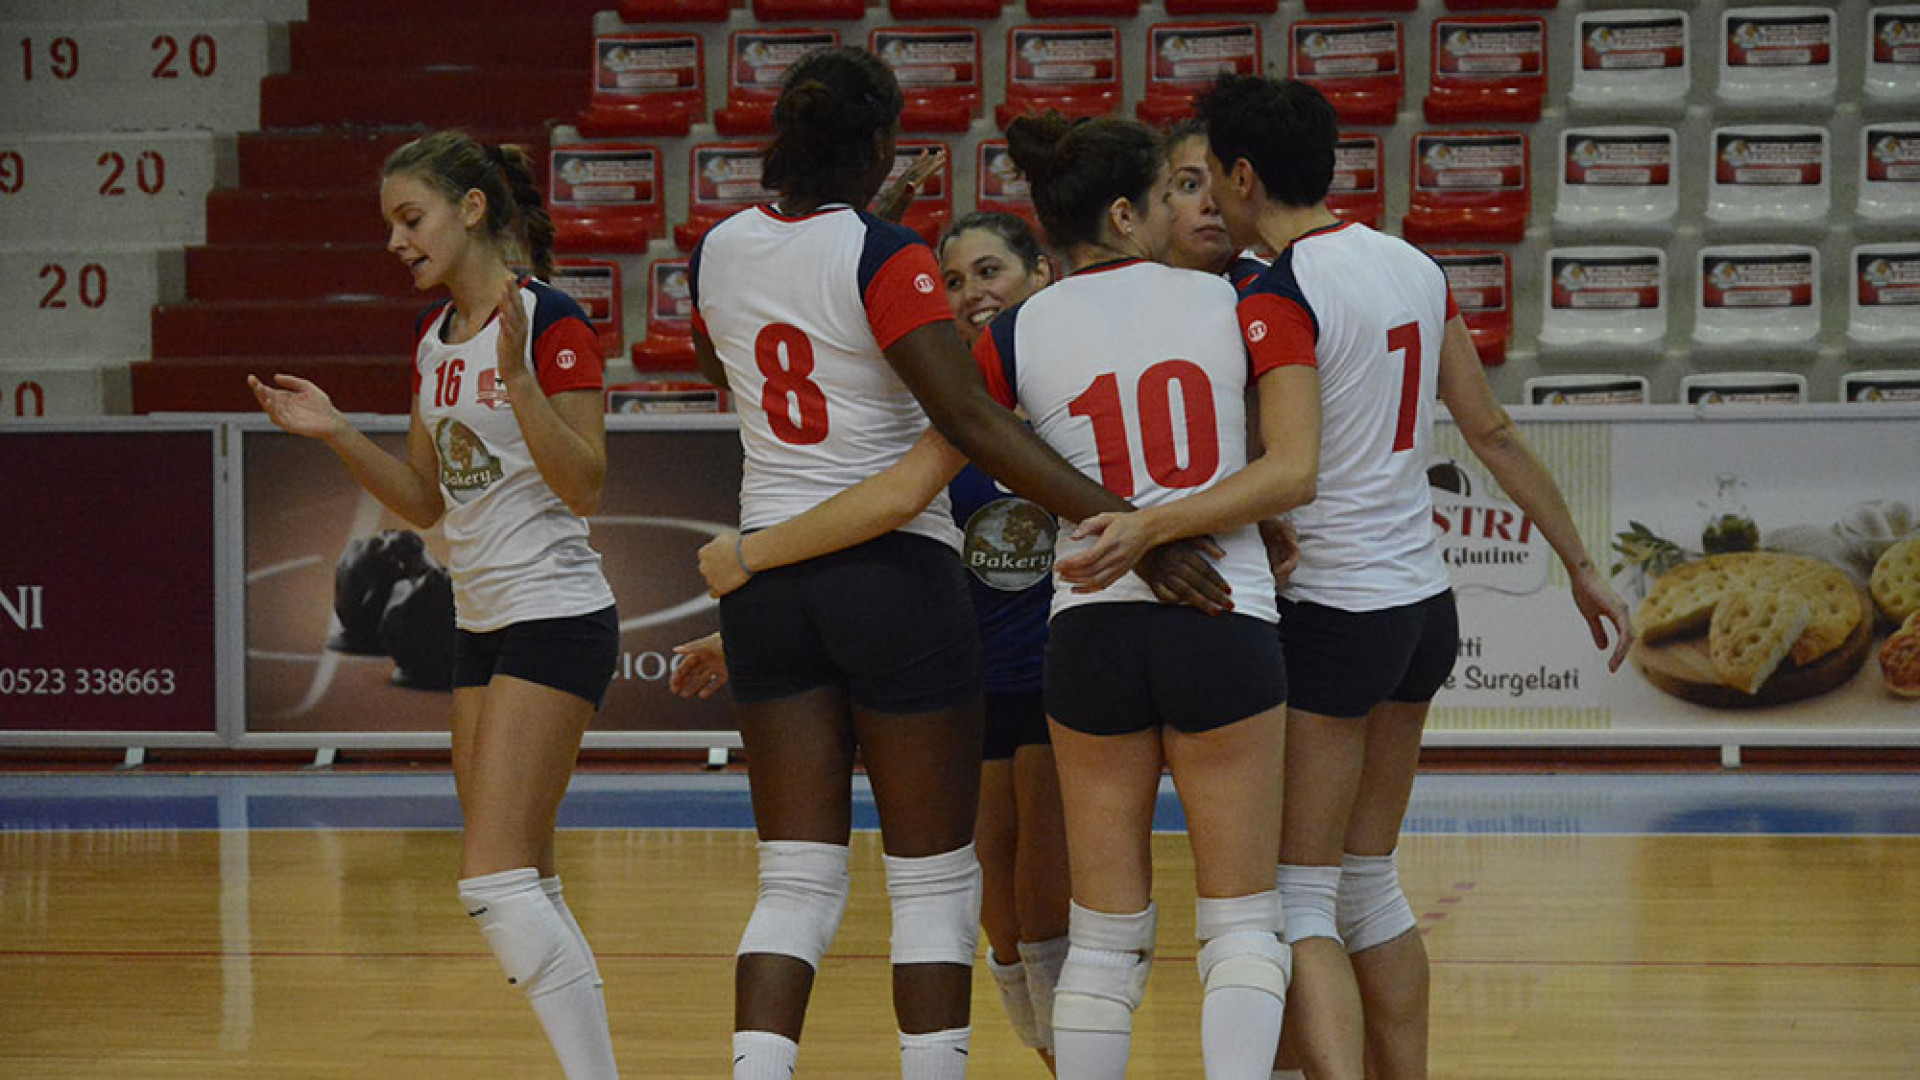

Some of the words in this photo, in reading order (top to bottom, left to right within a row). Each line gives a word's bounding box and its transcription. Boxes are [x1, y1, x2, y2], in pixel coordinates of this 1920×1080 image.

[20, 37, 79, 81] 19
[152, 34, 216, 78] 20
[98, 151, 165, 195] 20
[39, 263, 107, 309] 20
[434, 358, 466, 408] 16
[755, 321, 829, 445] 8
[1387, 320, 1421, 453] 7
[1068, 358, 1220, 498] 10
[971, 551, 1053, 571] Bakery
[0, 667, 66, 695] 0523
[74, 667, 176, 695] 338663
[1464, 664, 1579, 697] Surgelati
